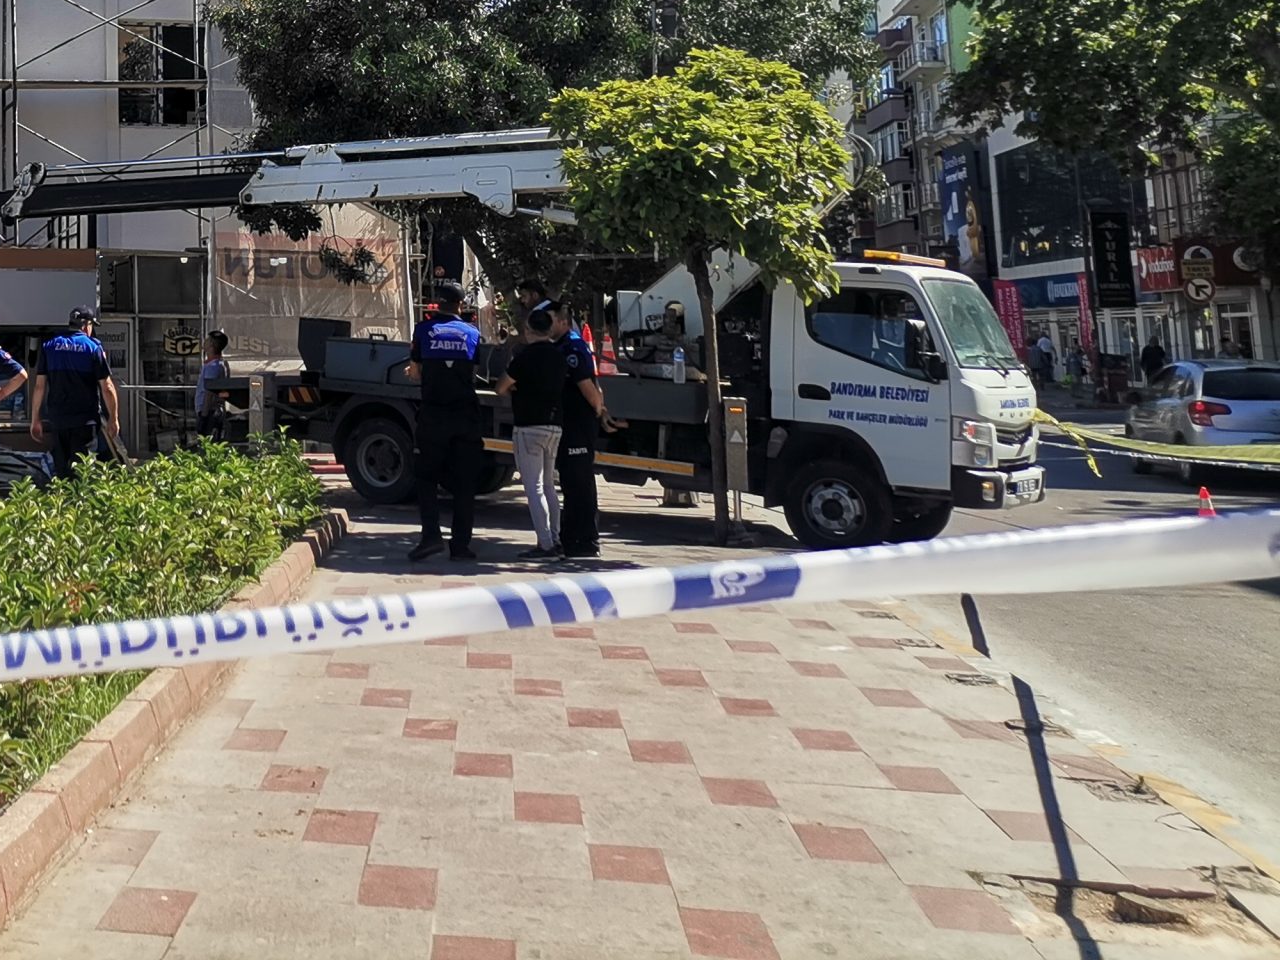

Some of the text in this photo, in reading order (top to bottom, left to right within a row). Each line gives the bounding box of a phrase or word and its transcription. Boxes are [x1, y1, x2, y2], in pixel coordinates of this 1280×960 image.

[1148, 257, 1175, 273] vodafone
[429, 339, 469, 353] ZABITA
[830, 381, 930, 403] BANDIRMA BELEDİYESİ
